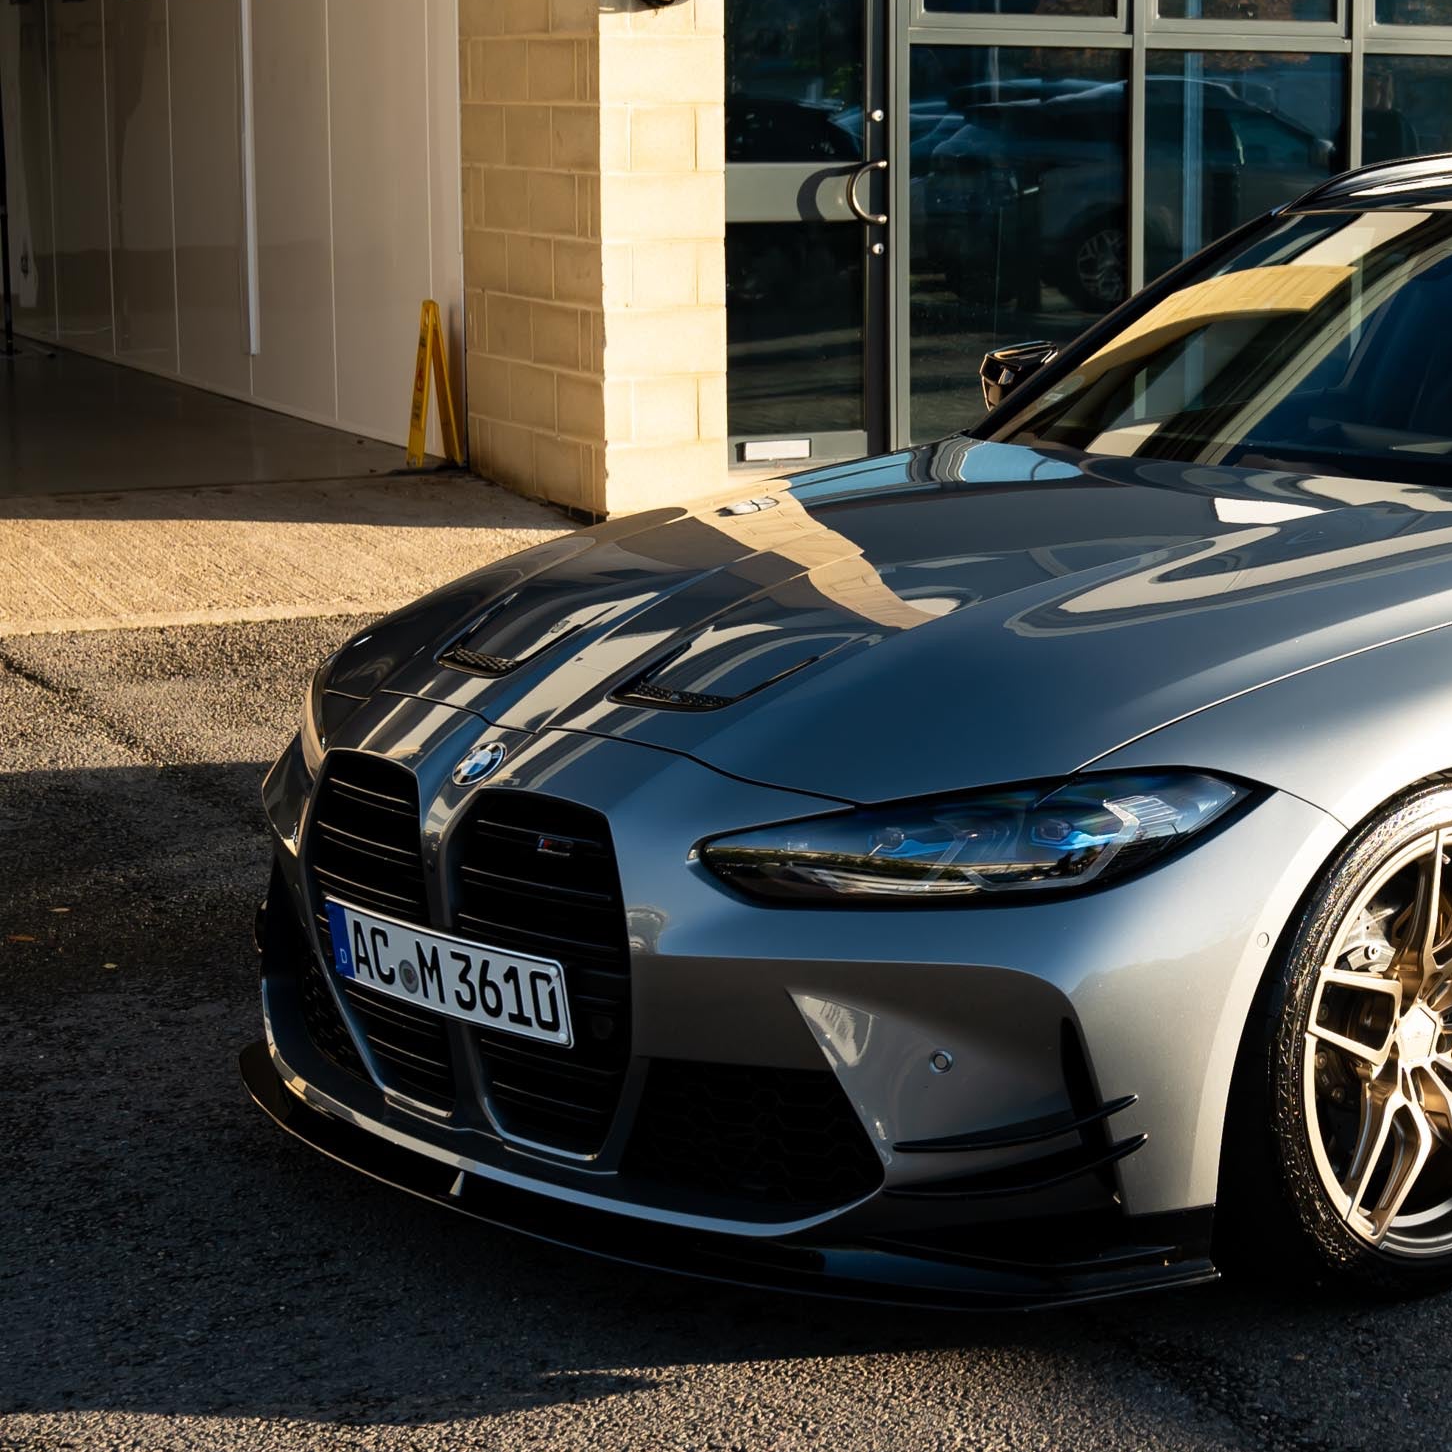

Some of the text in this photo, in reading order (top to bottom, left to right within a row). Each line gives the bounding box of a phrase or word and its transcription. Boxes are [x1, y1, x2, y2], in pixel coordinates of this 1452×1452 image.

[339, 948, 348, 964] D
[353, 919, 561, 1033] AC M 3610
